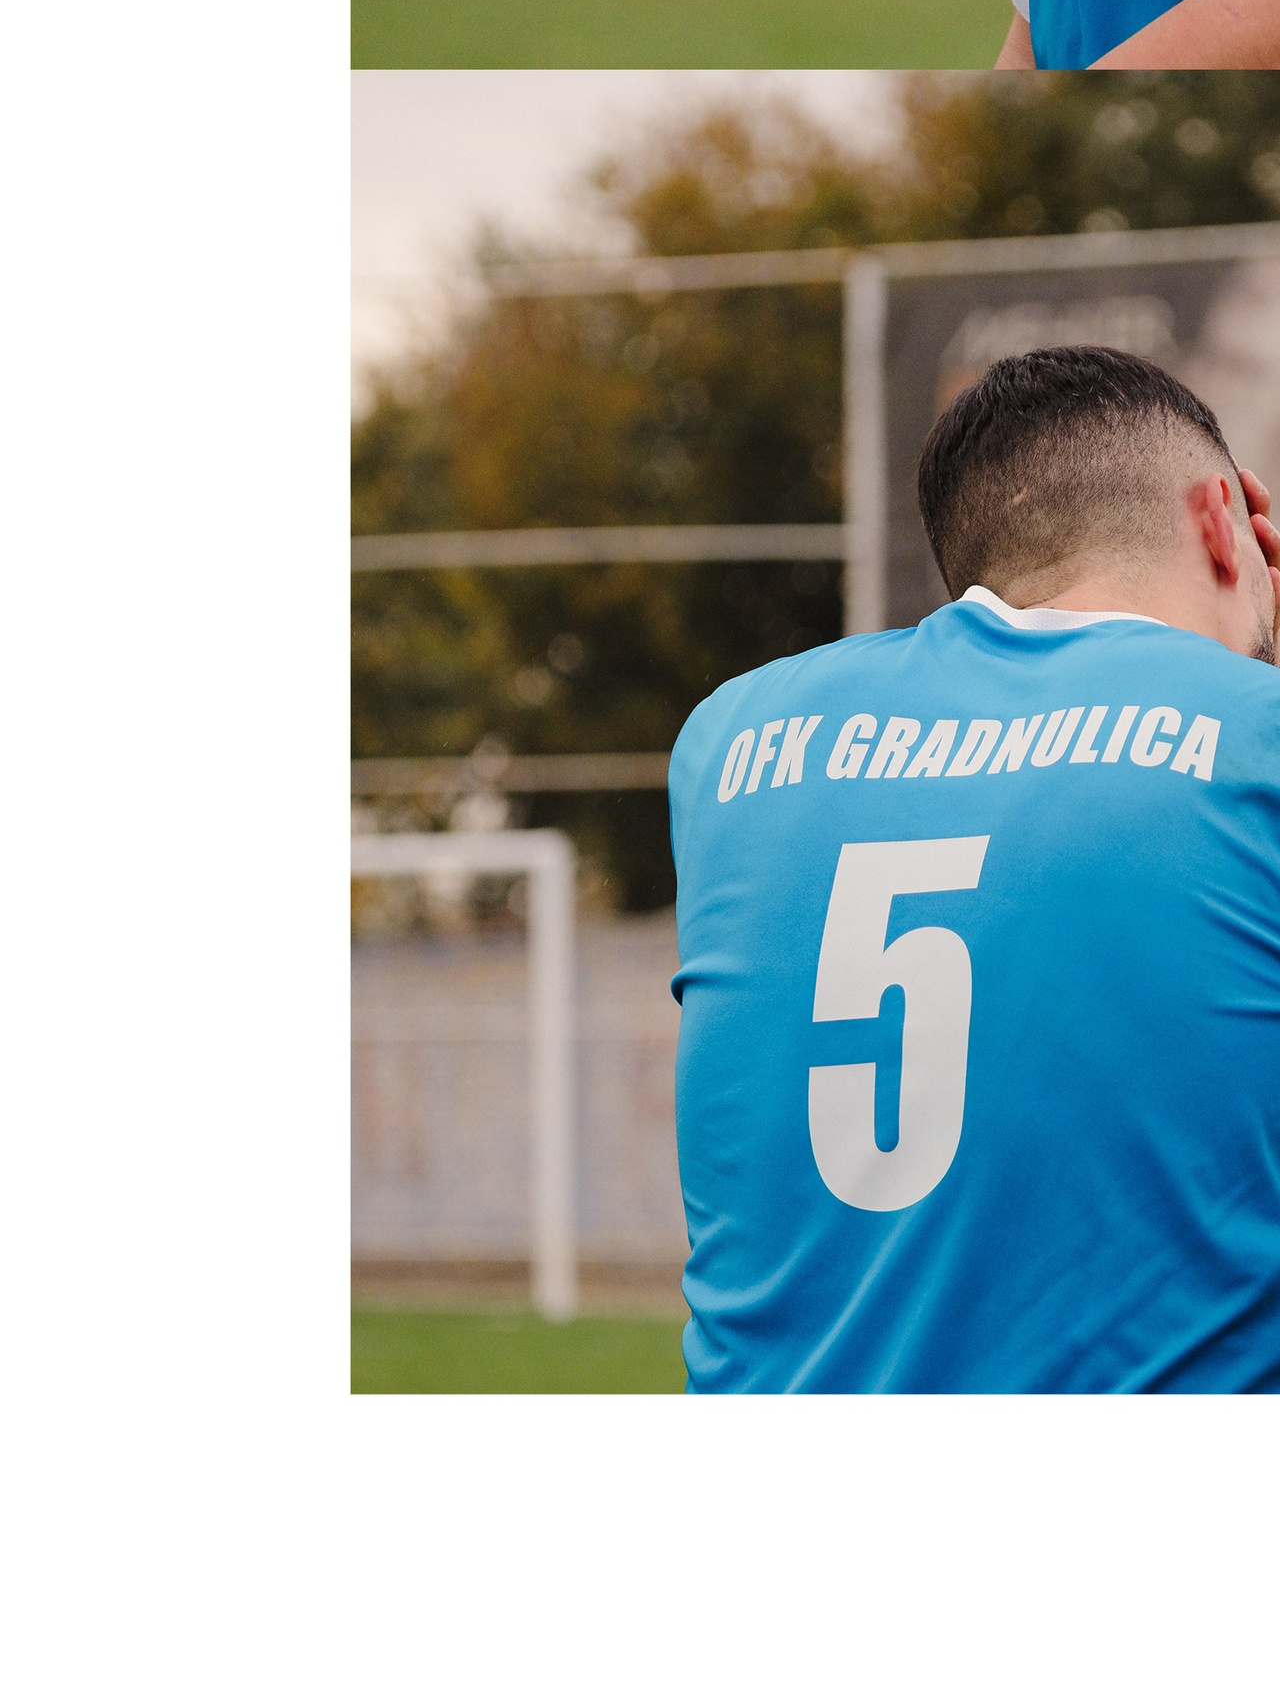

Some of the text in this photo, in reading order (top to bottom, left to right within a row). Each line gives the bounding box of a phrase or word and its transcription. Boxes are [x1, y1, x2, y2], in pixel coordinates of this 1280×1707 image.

[717, 705, 1222, 803] OFK GRADNULICA
[808, 835, 991, 1212] 5
